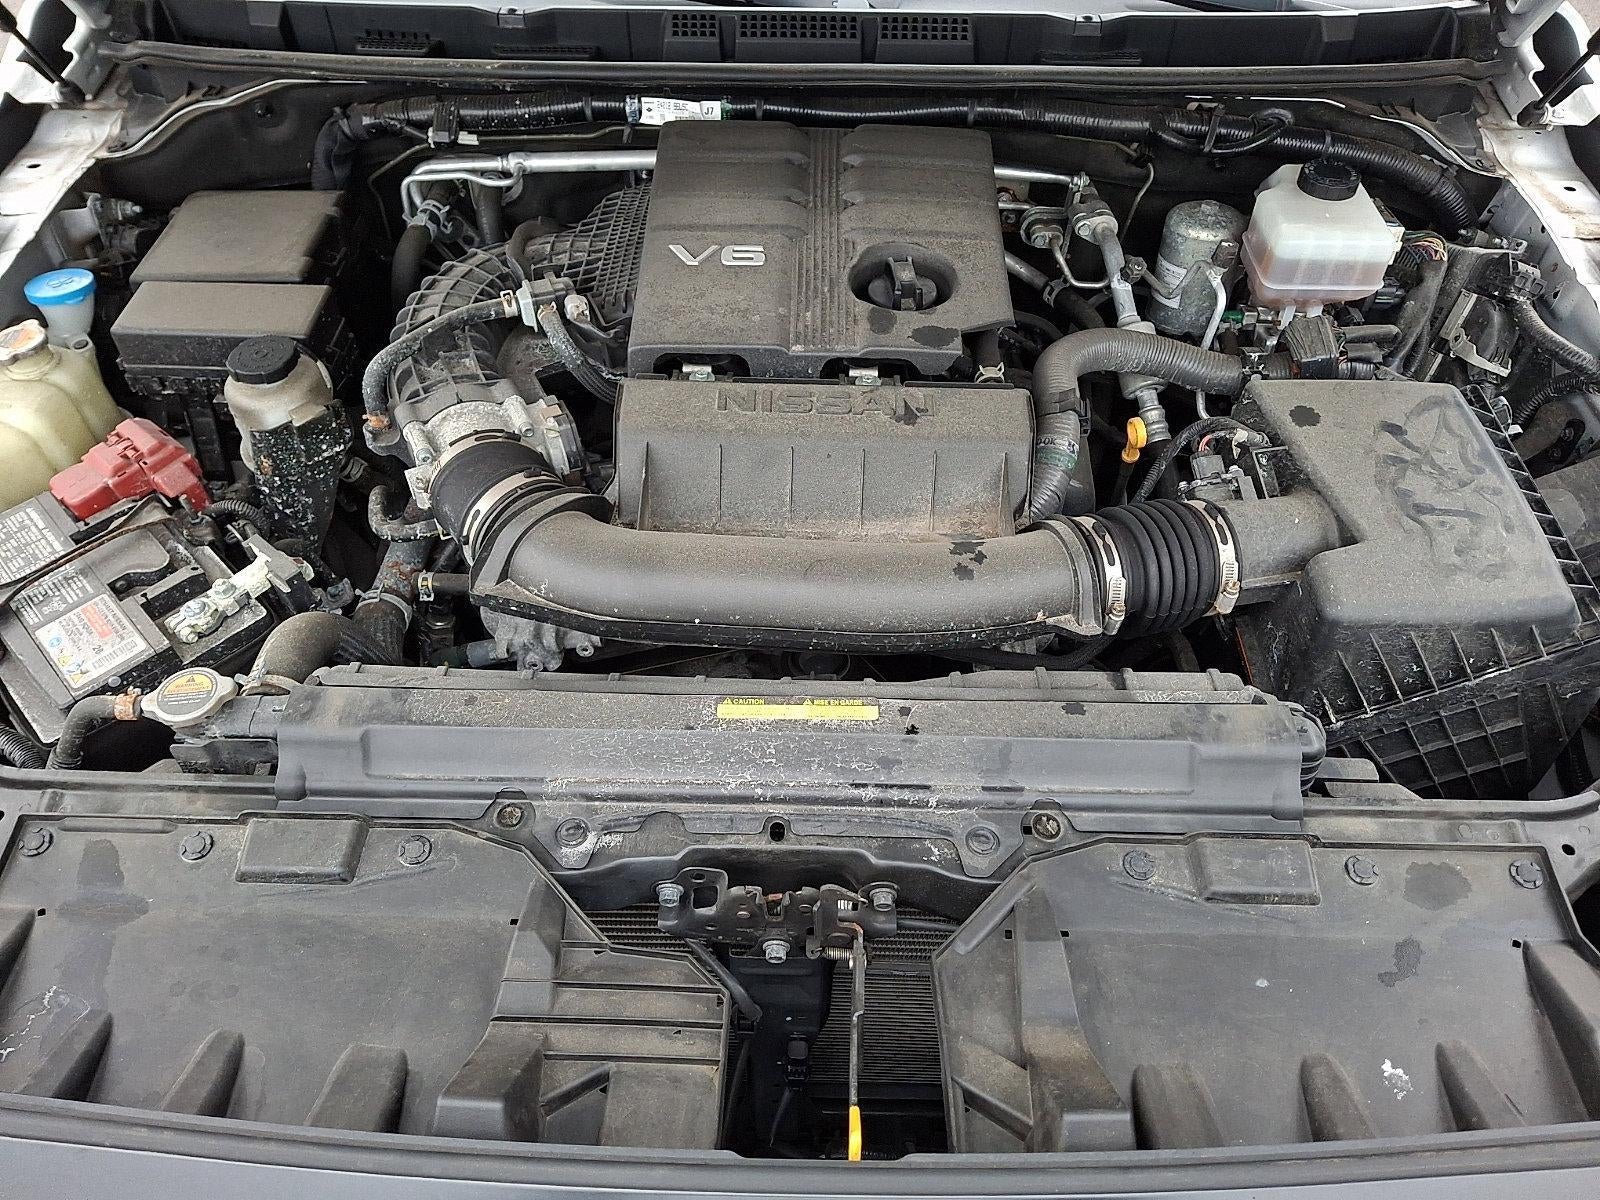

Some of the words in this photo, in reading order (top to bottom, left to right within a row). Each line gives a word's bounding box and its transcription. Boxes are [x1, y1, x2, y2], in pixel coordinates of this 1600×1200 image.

[704, 106, 715, 116] J7
[668, 244, 766, 266] V6
[715, 389, 936, 416] NISSAN
